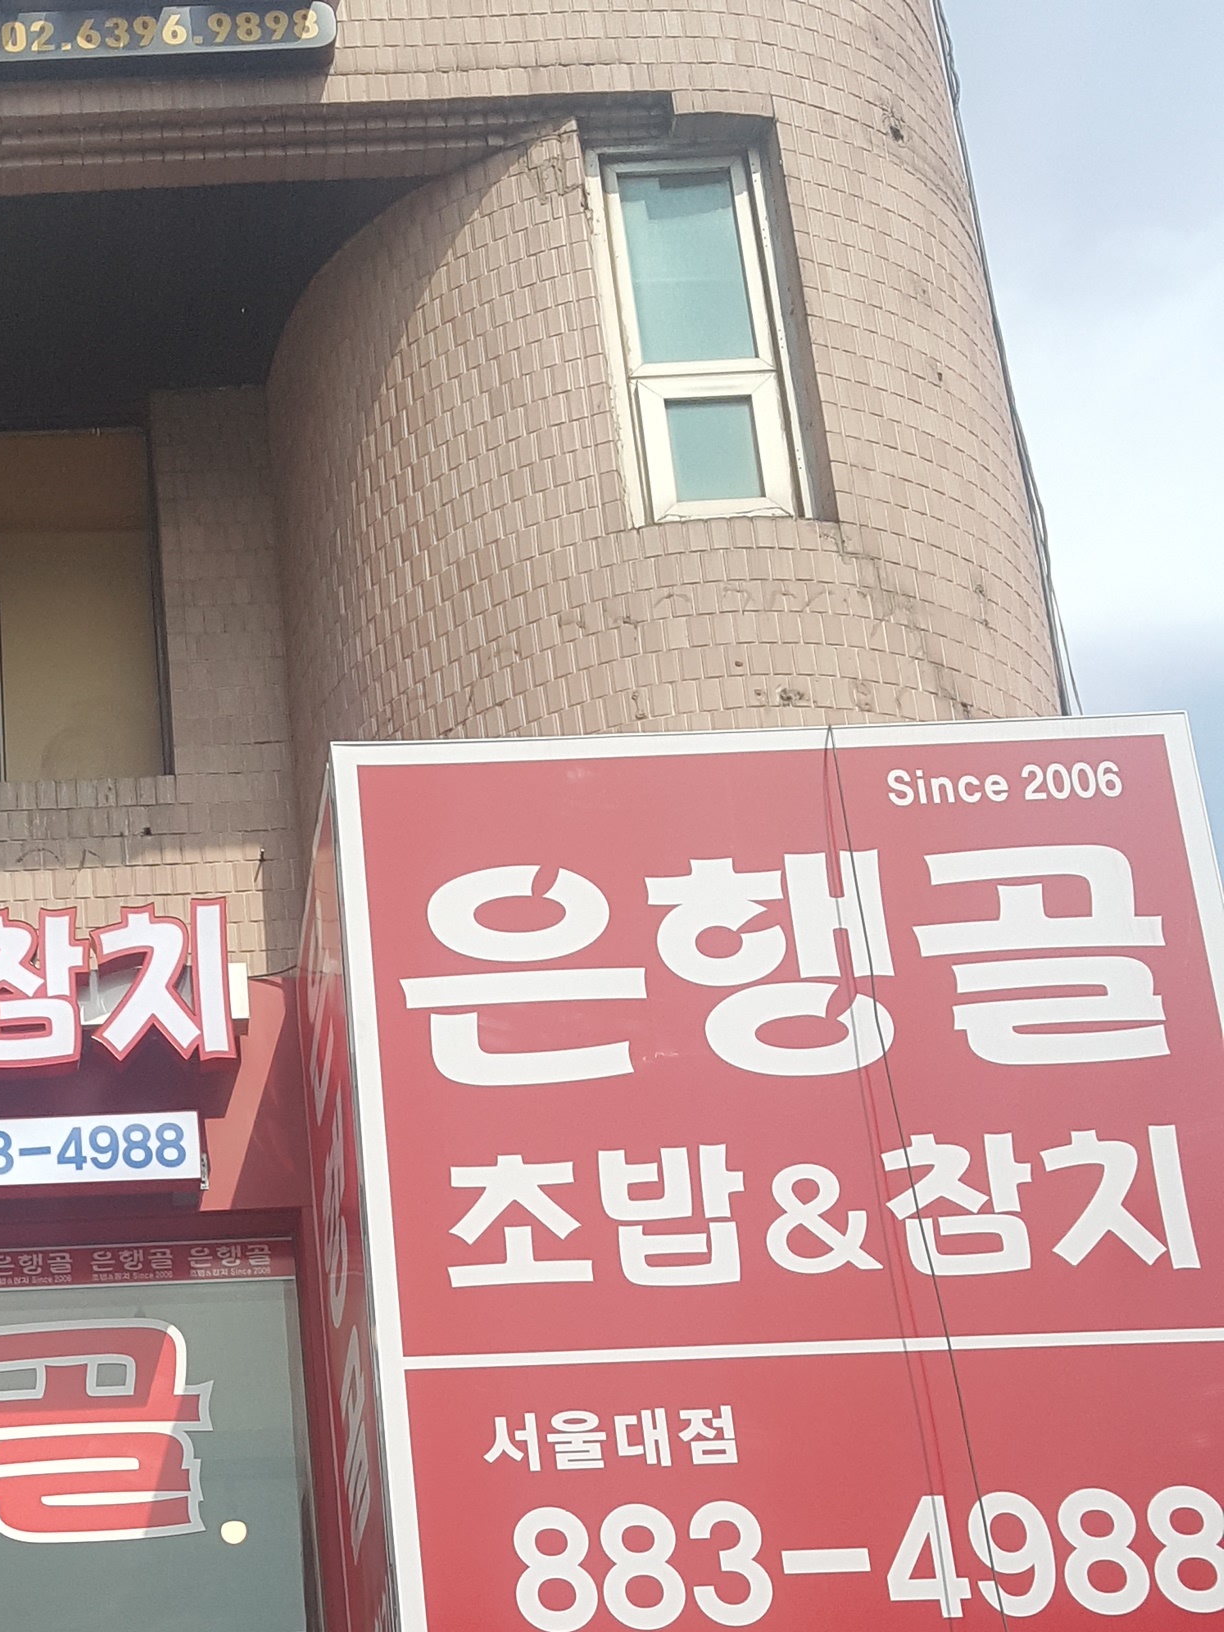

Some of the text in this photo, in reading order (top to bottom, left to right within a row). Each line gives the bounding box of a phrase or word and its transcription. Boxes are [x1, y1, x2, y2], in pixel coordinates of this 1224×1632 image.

[886, 760, 1124, 807] Since 2006
[399, 844, 1171, 1087] 은행골
[447, 1123, 1202, 1288] 초밥&참치
[91, 1248, 174, 1271] 은행골
[188, 1244, 271, 1267] 은행골
[231, 1268, 252, 1276] Since
[32, 1276, 52, 1284] Since
[482, 1404, 740, 1472] 서울대점
